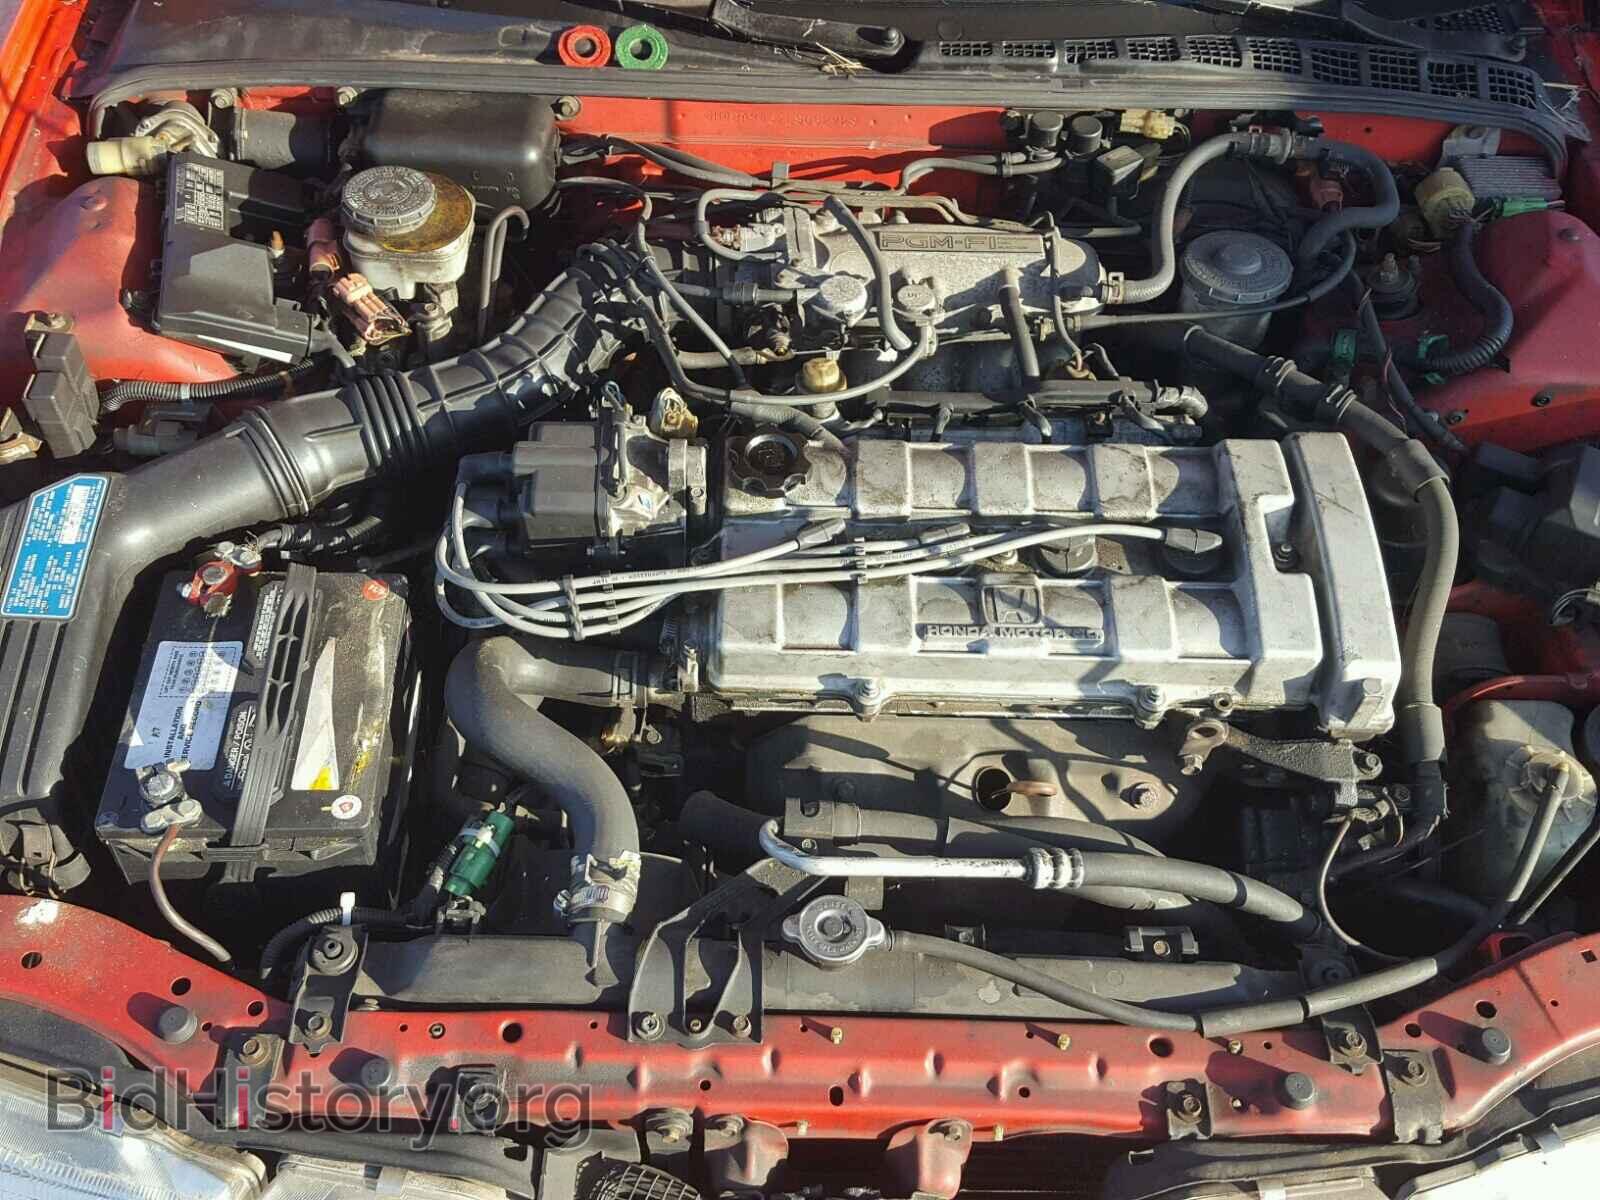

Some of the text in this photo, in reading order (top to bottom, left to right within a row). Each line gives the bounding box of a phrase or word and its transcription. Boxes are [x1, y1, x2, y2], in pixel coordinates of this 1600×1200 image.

[882, 234, 996, 249] PGM-FI
[927, 624, 995, 639] HONDA
[1000, 626, 1068, 640] MOTOR
[164, 706, 184, 758] INSTALLATION
[233, 711, 248, 738] POISON
[181, 731, 194, 759] ERVICE
